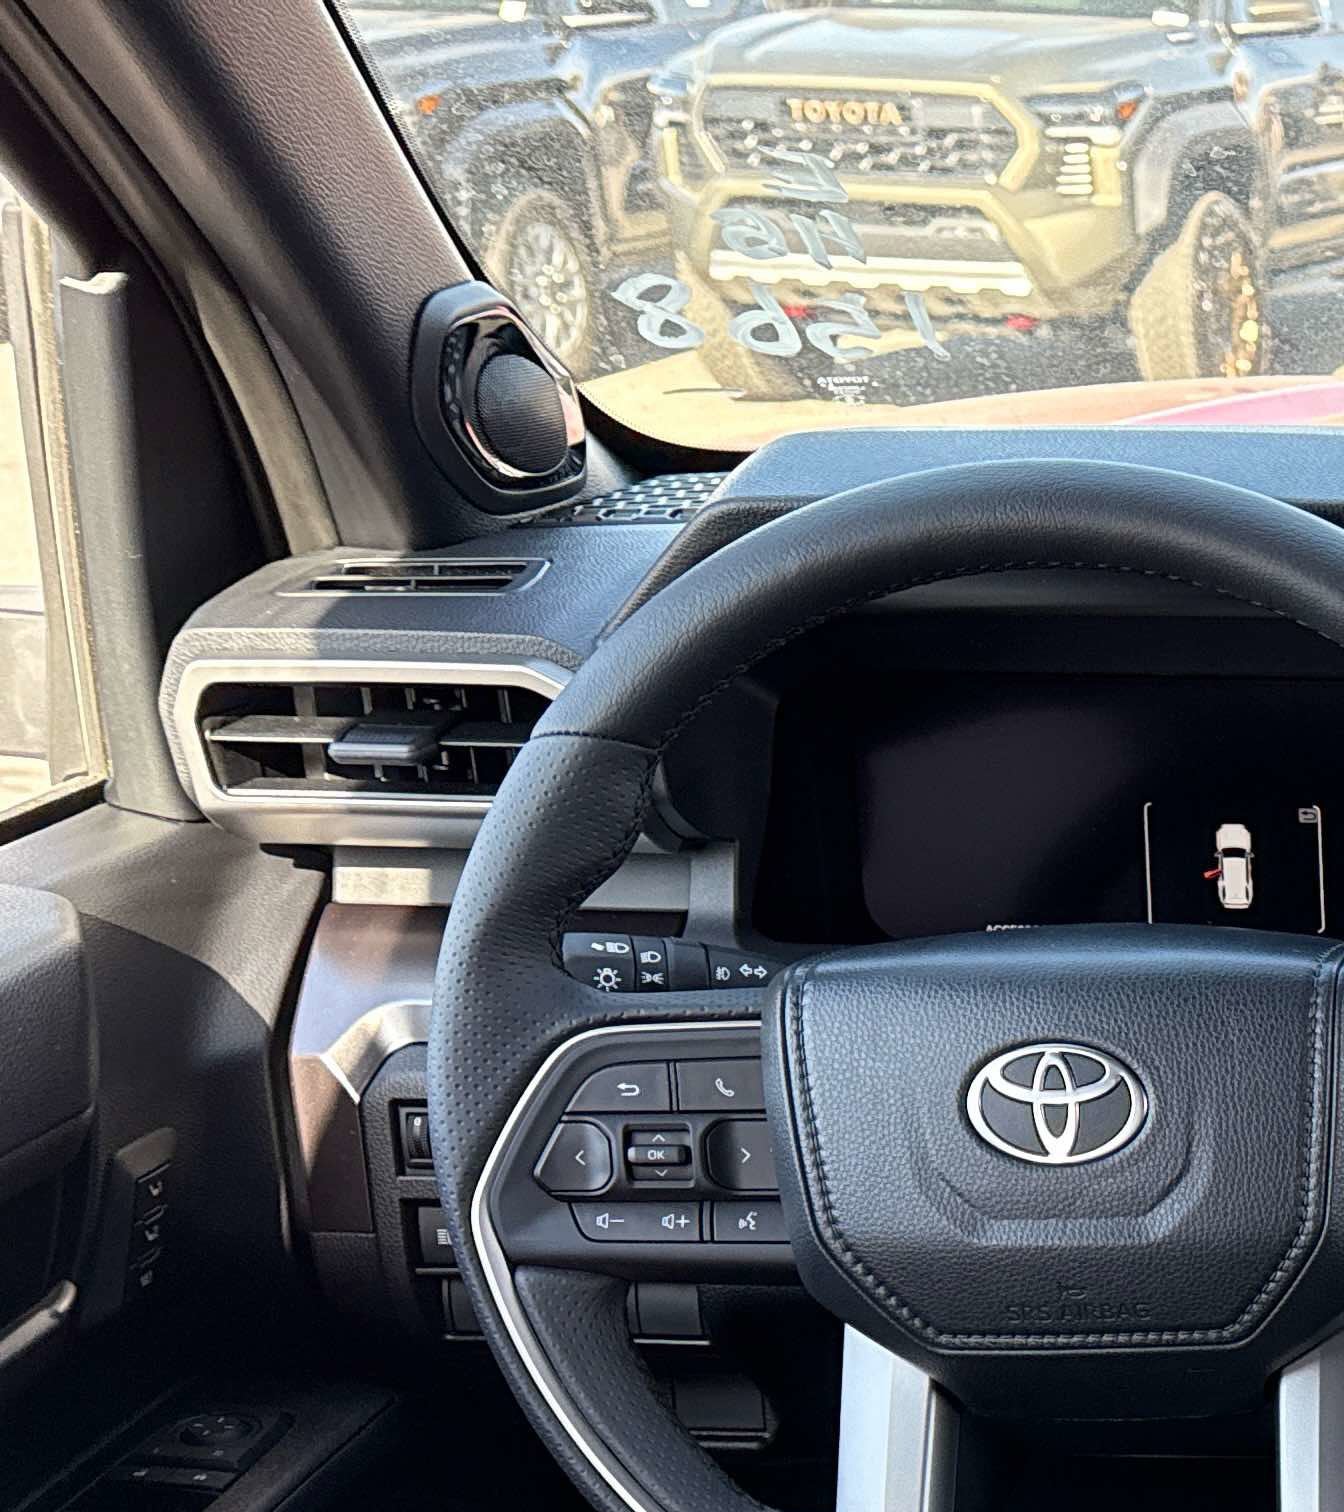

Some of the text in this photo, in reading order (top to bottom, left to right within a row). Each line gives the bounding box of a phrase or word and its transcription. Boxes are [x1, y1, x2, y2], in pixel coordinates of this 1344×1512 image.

[784, 97, 903, 127] TOYOTA
[647, 1150, 665, 1161] OK
[1008, 1303, 1152, 1324] SRS AIRBAG
